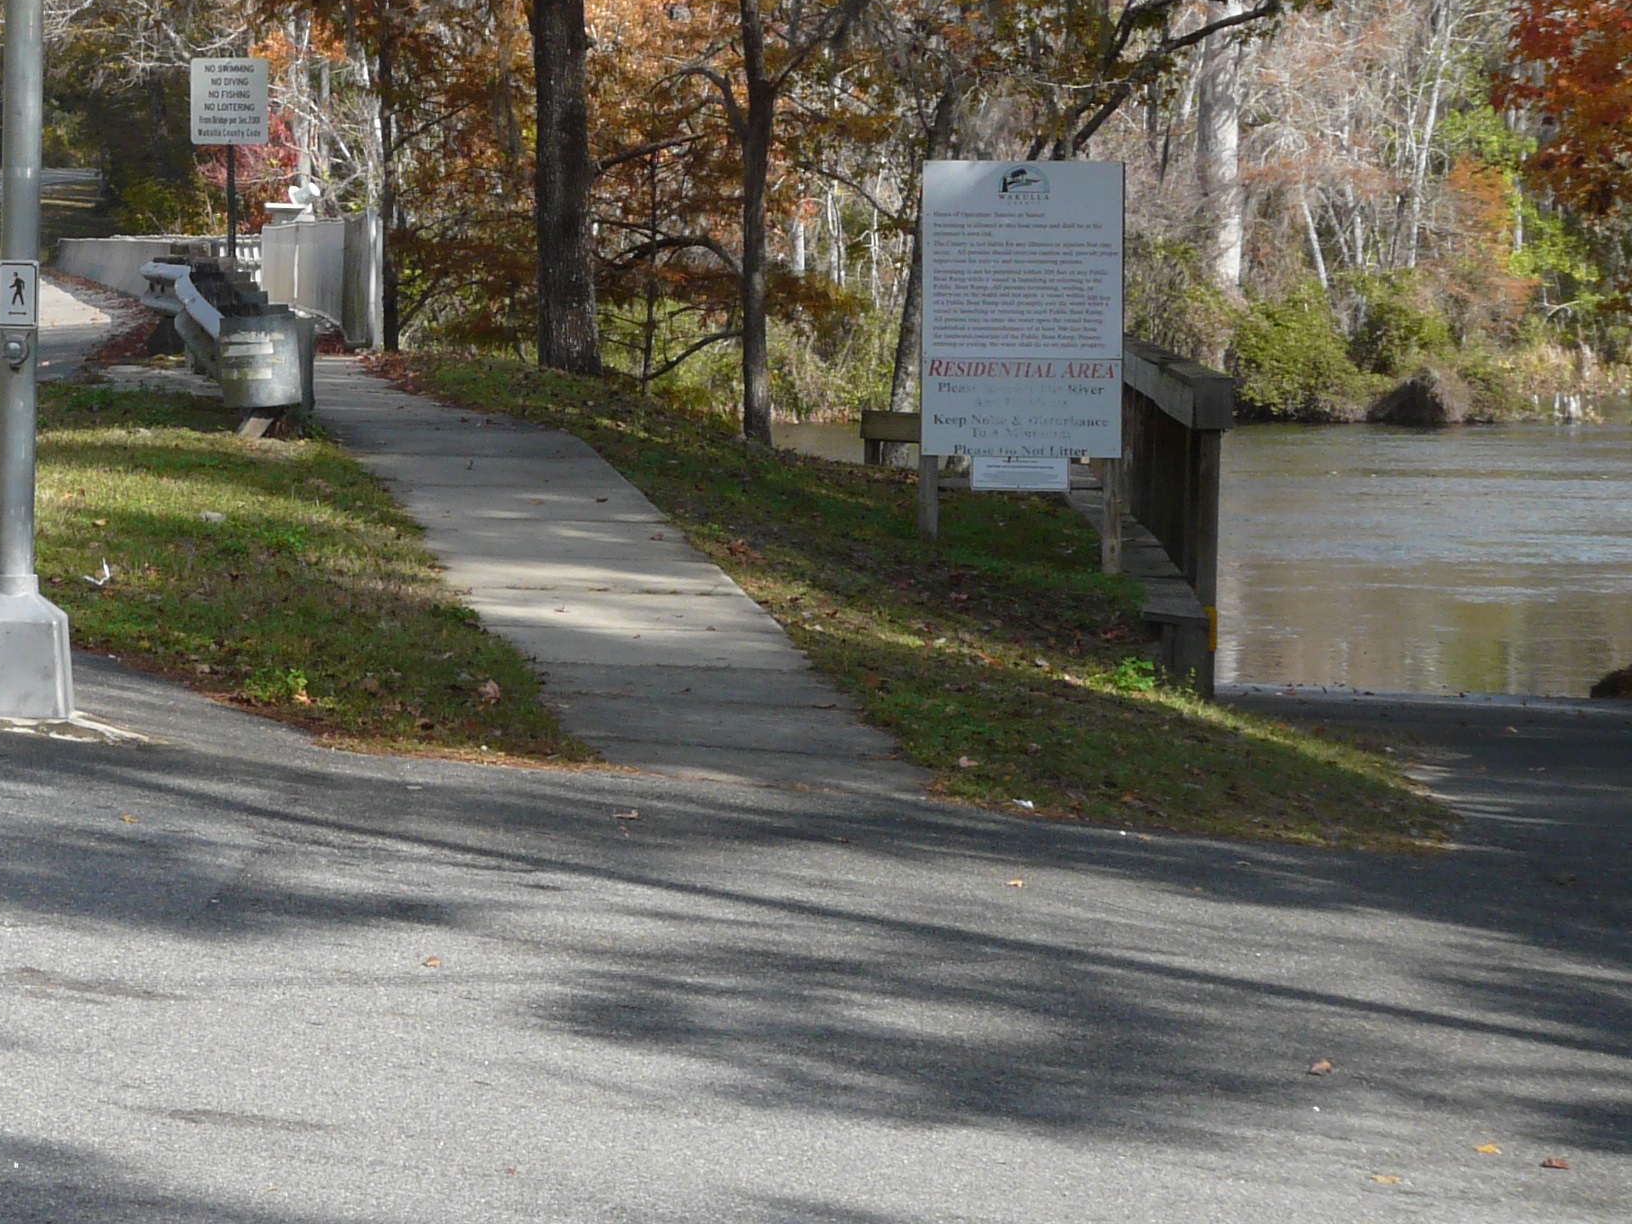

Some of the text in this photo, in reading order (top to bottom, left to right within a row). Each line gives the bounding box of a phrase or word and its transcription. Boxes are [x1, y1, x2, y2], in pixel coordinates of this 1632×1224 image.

[205, 65, 255, 73] NO SWIMMING
[211, 77, 249, 86] NO DIVING
[209, 90, 250, 99] NO FISHING
[204, 102, 255, 111] NO LOITERING
[197, 128, 261, 138] Wakulla County Code
[928, 359, 1115, 379] RESIDENTIAL AREA
[933, 414, 967, 428] Keep
[954, 444, 994, 455] Please
[1021, 445, 1044, 456] Not
